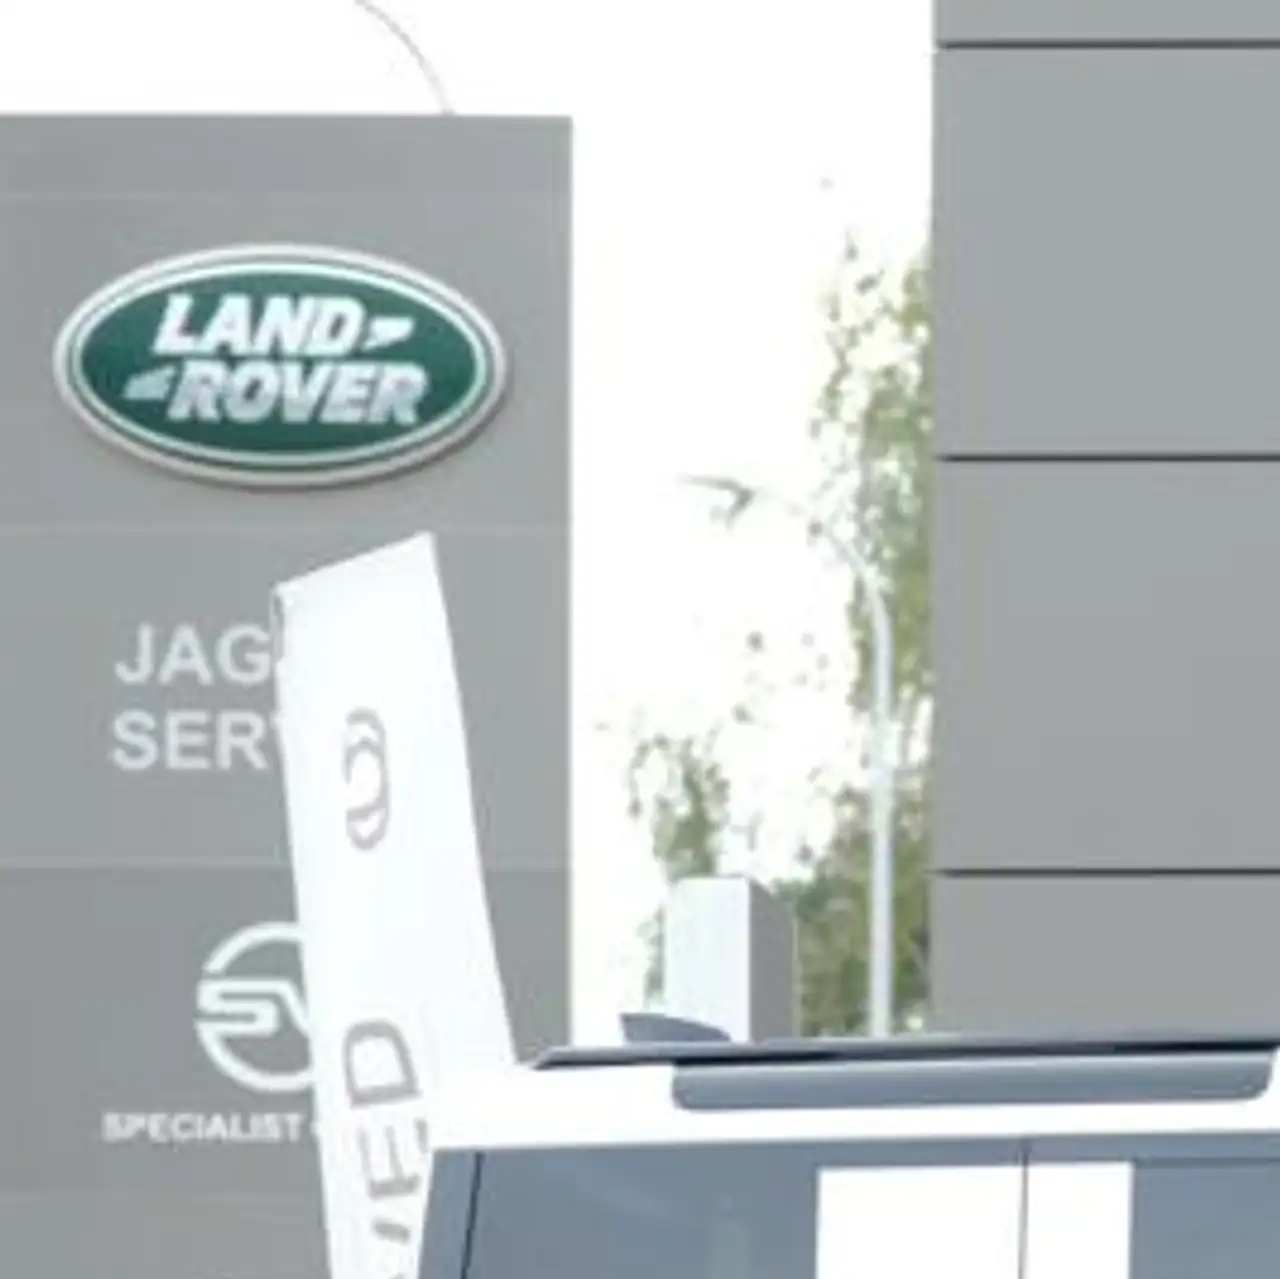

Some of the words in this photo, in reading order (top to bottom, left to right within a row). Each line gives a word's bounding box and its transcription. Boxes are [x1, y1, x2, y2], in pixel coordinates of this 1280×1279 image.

[153, 293, 364, 356] LAND
[168, 360, 430, 424] ROVER
[114, 623, 272, 686] JAG
[112, 709, 280, 771] SER
[101, 1112, 303, 1142] SPECIALIST
